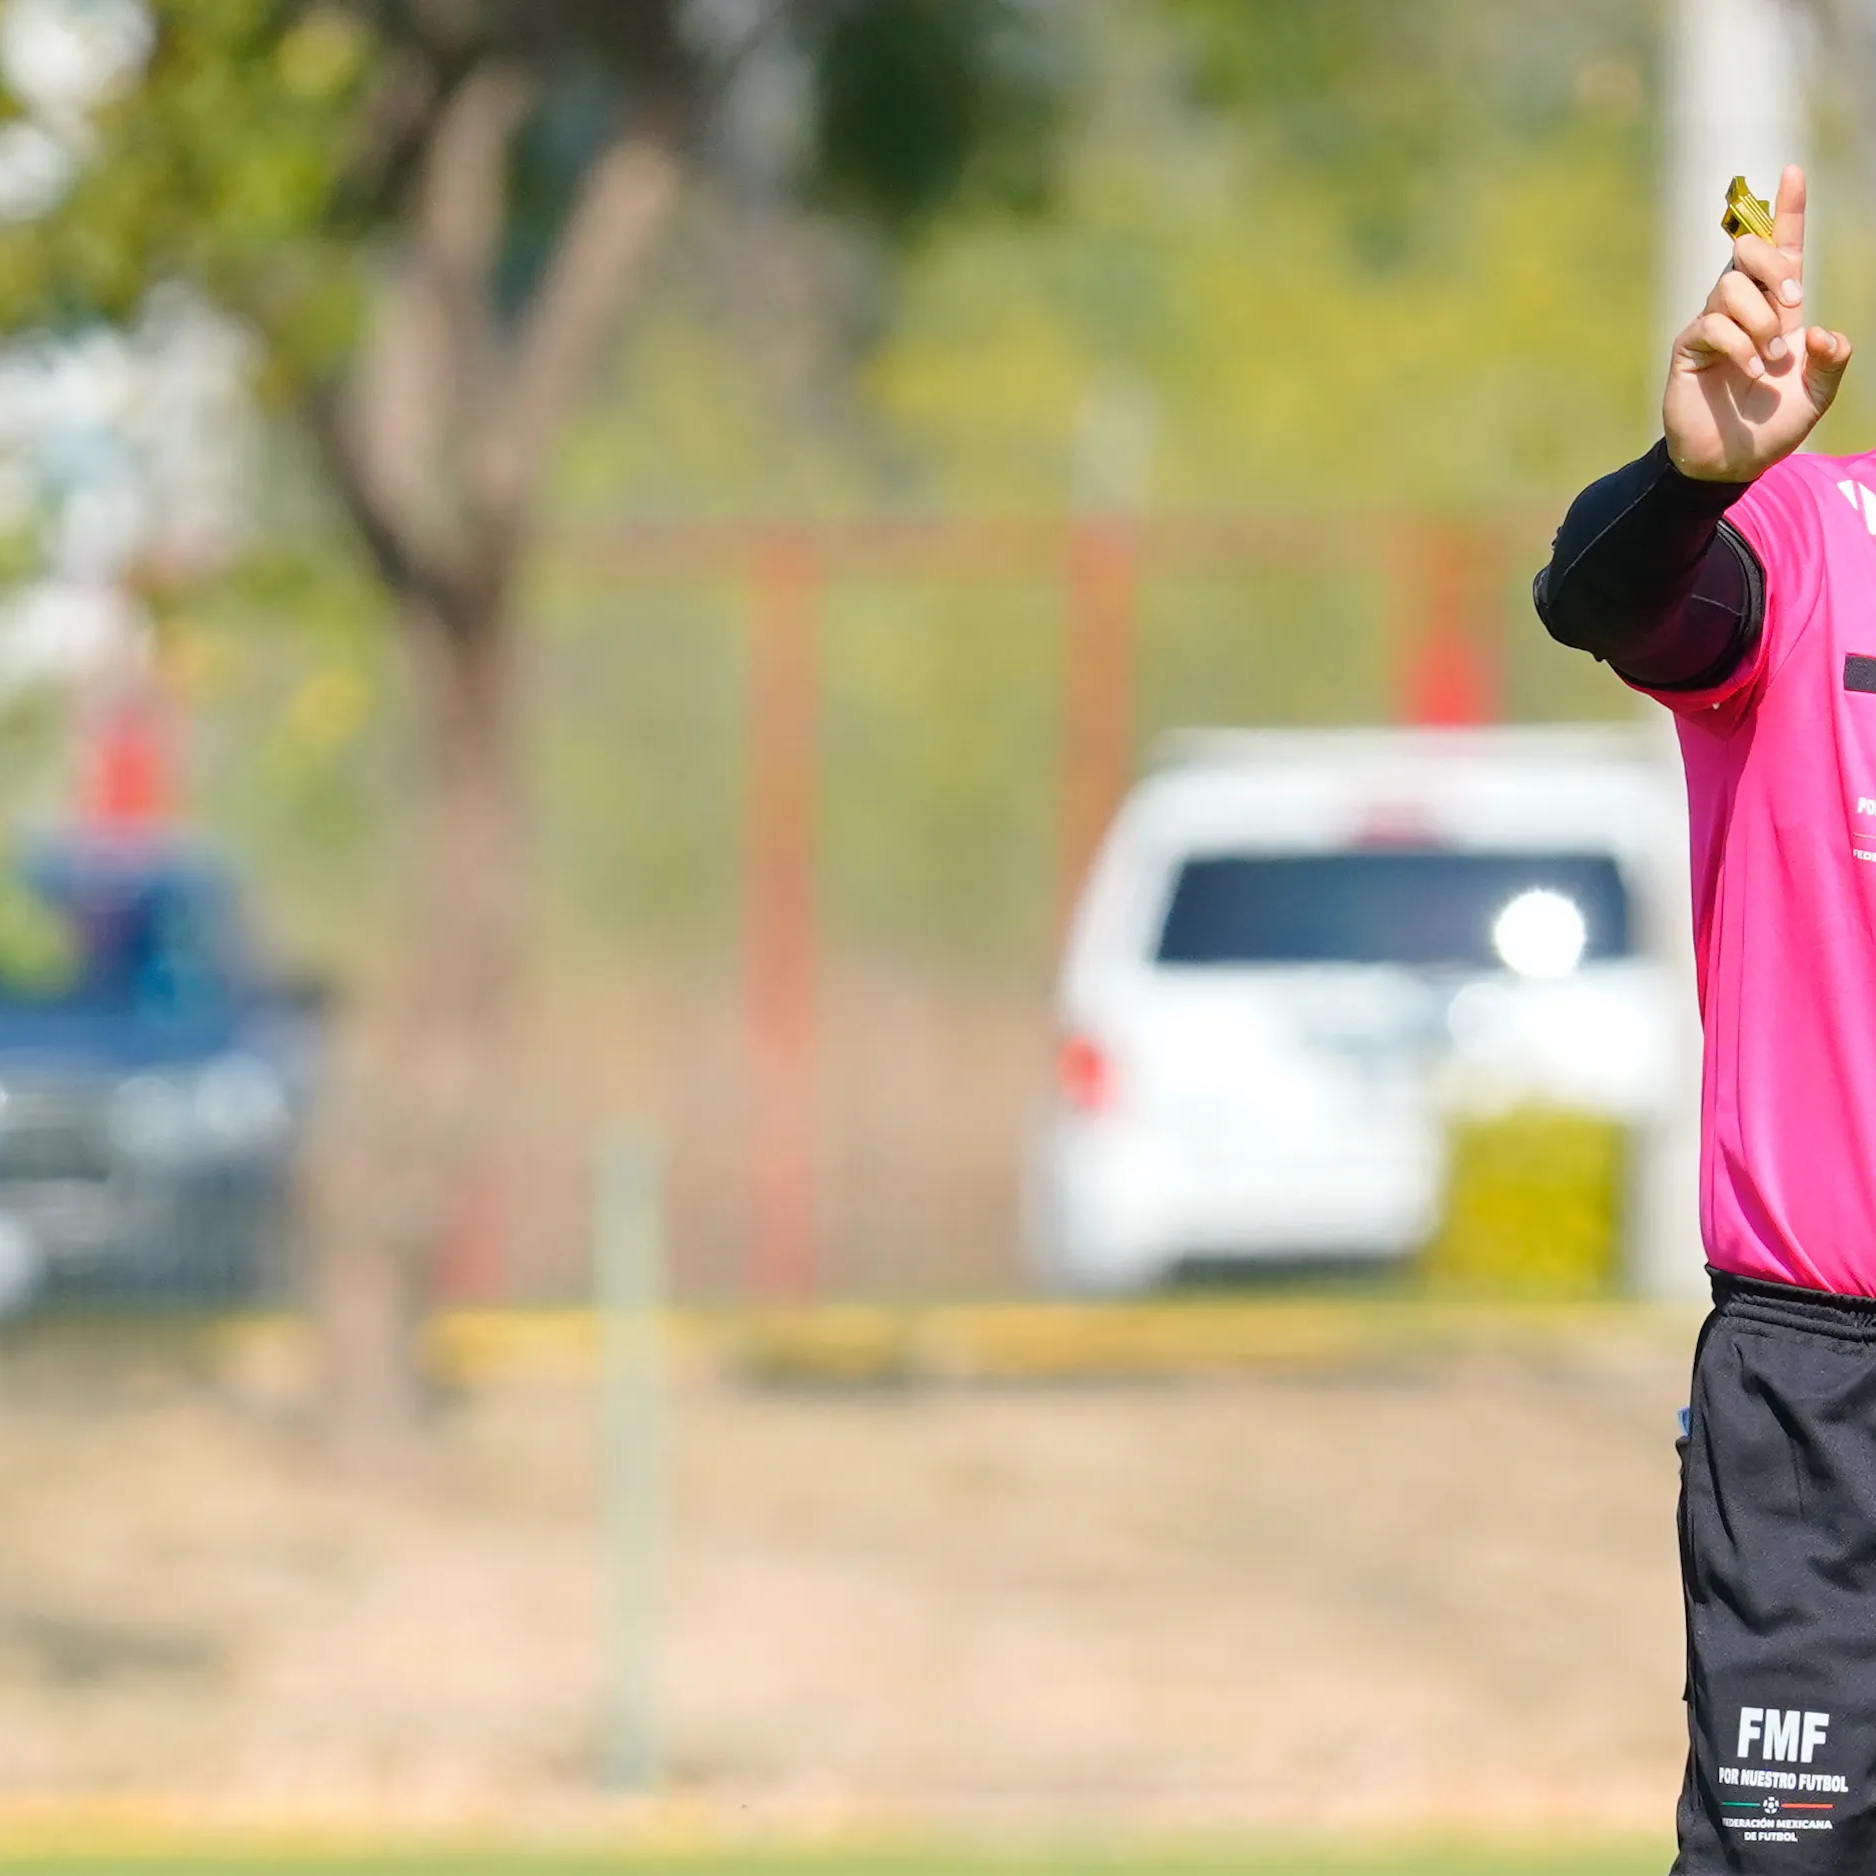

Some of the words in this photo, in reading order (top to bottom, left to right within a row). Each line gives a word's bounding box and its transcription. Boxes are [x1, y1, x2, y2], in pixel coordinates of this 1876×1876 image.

[1737, 1706, 1830, 1764] FMF
[1718, 1767, 1740, 1785] POR
[1740, 1769, 1797, 1791] NUESTRO
[1798, 1774, 1849, 1793] FUTBOL
[1776, 1819, 1833, 1830] MEXICANA
[1744, 1831, 1758, 1841] DE
[1758, 1832, 1798, 1842] FUTBOL
